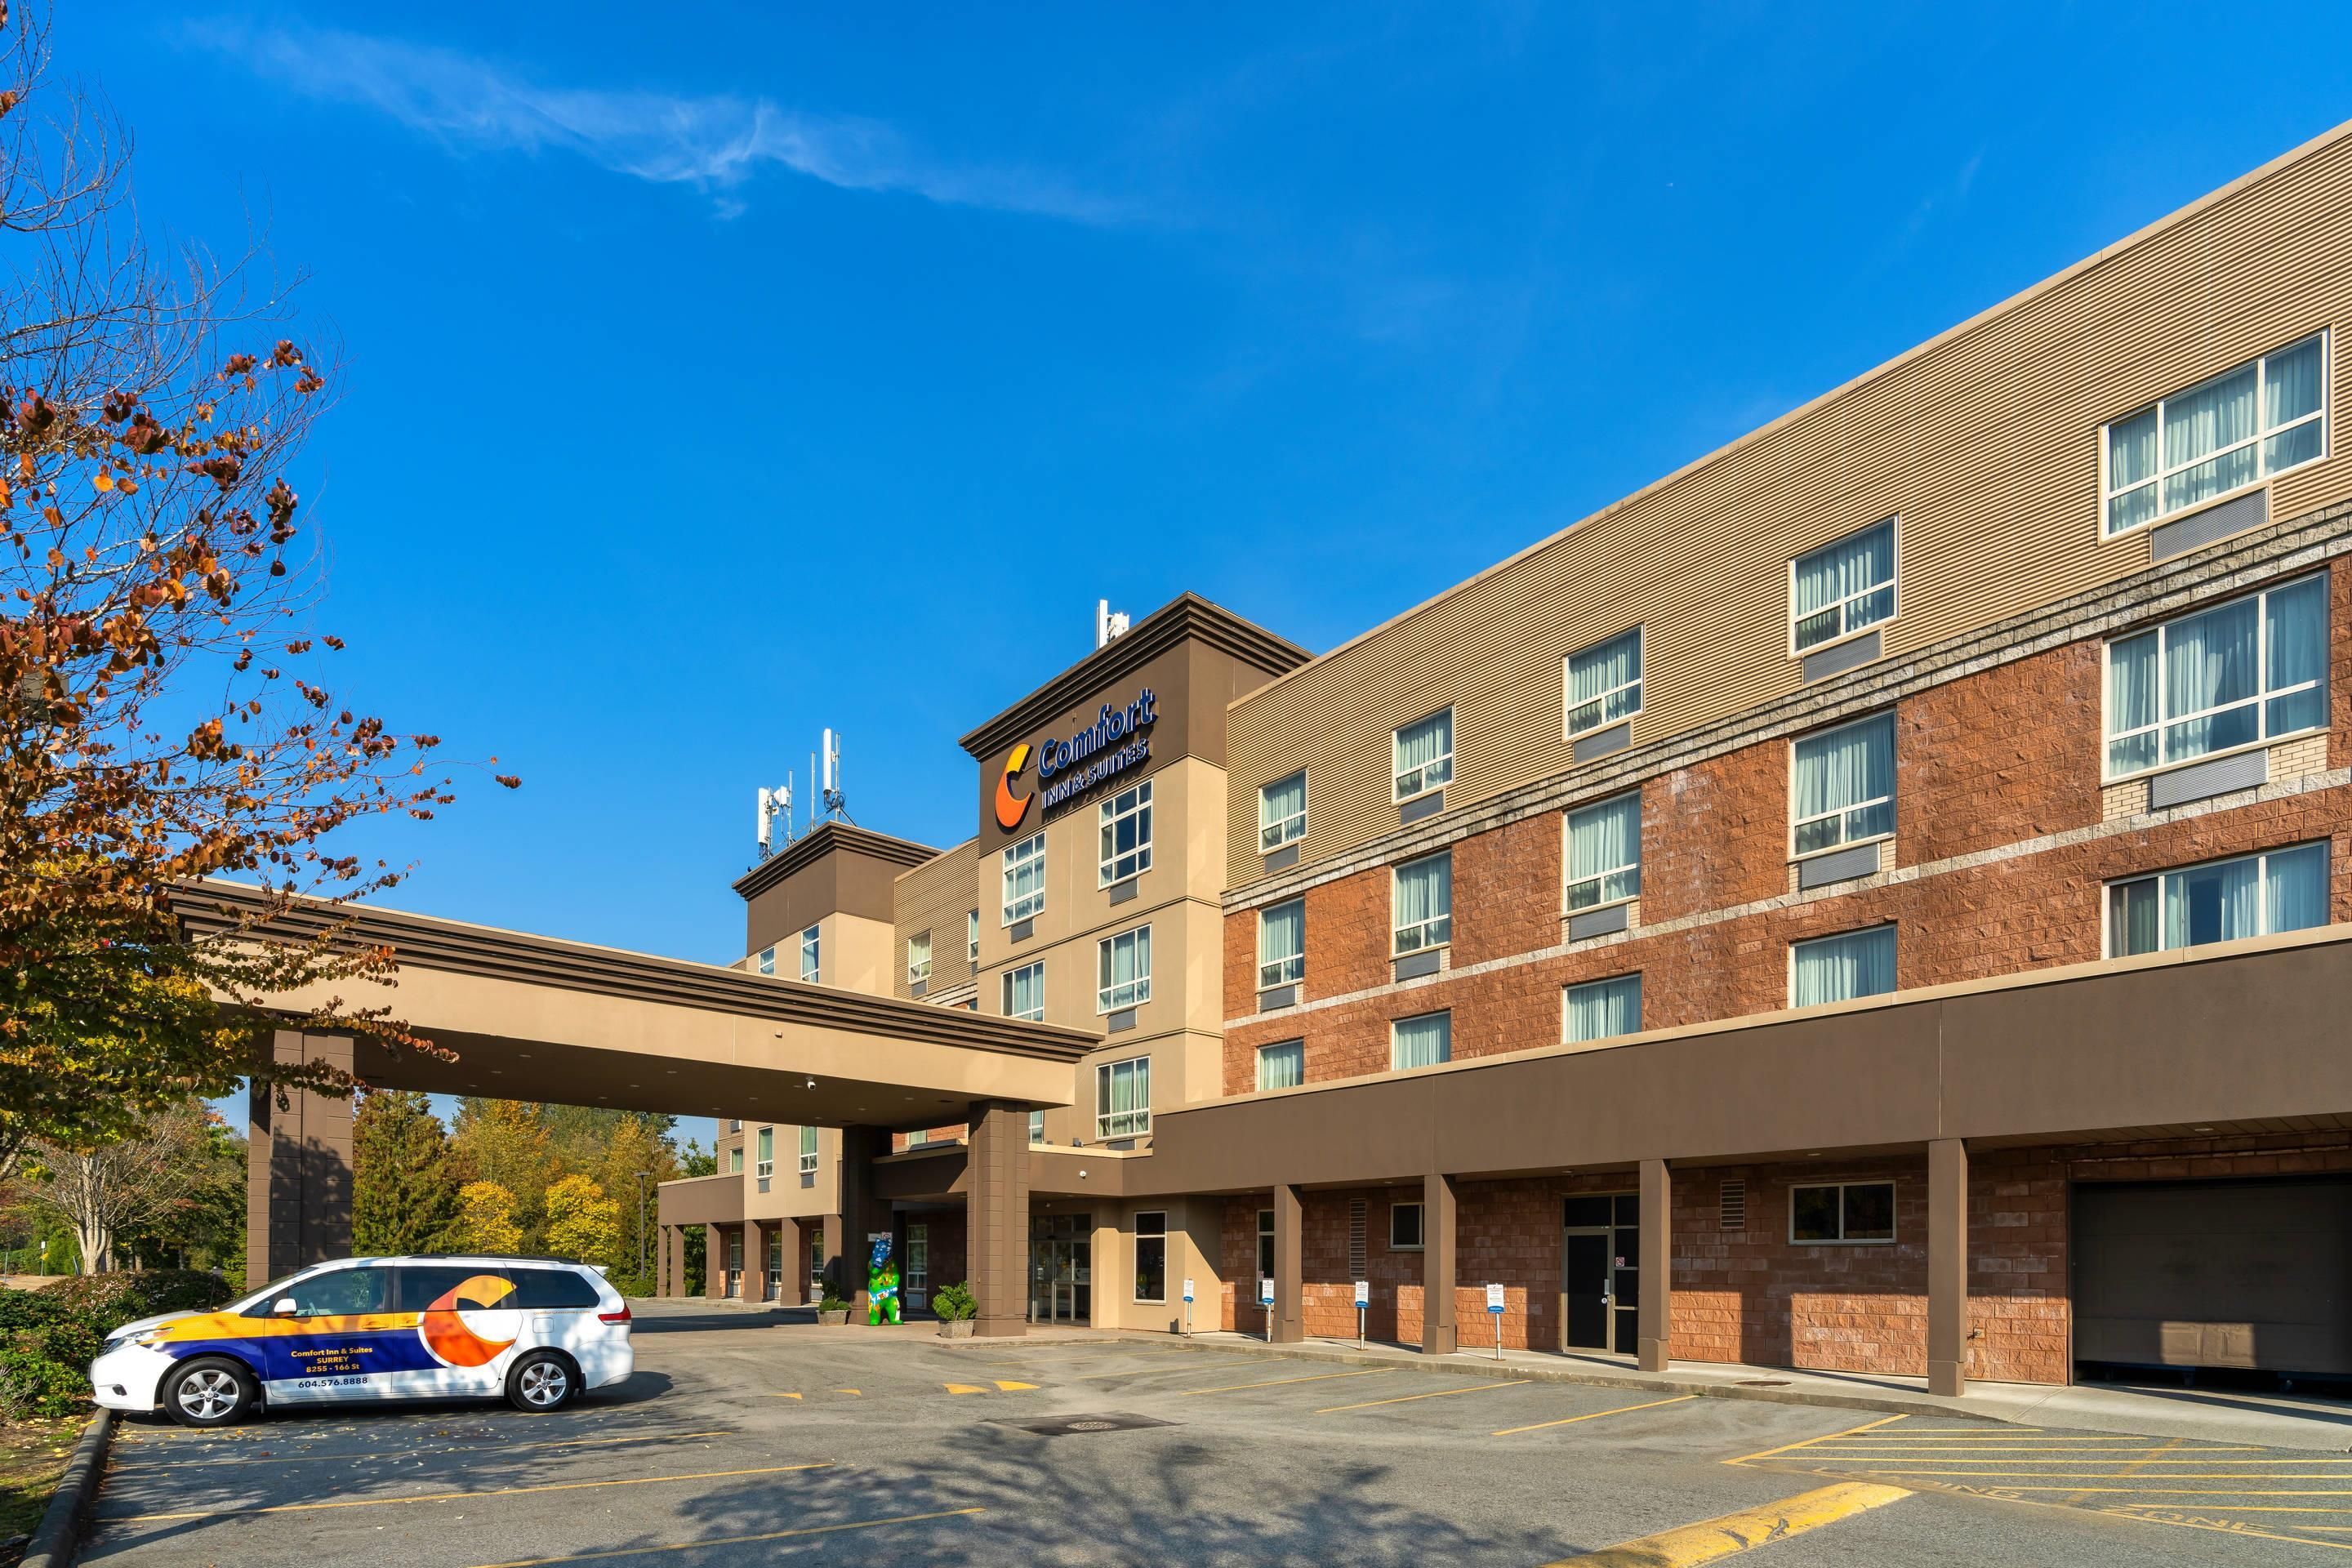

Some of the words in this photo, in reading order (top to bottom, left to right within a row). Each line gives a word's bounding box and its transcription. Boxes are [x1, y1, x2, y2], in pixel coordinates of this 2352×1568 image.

[1038, 688, 1156, 778] Comfort
[1041, 778, 1070, 809] INN
[1072, 773, 1085, 792] &
[1087, 738, 1149, 785] SUITES
[291, 1349, 325, 1357] Comfort
[298, 1377, 368, 1388] 604.576.8888
